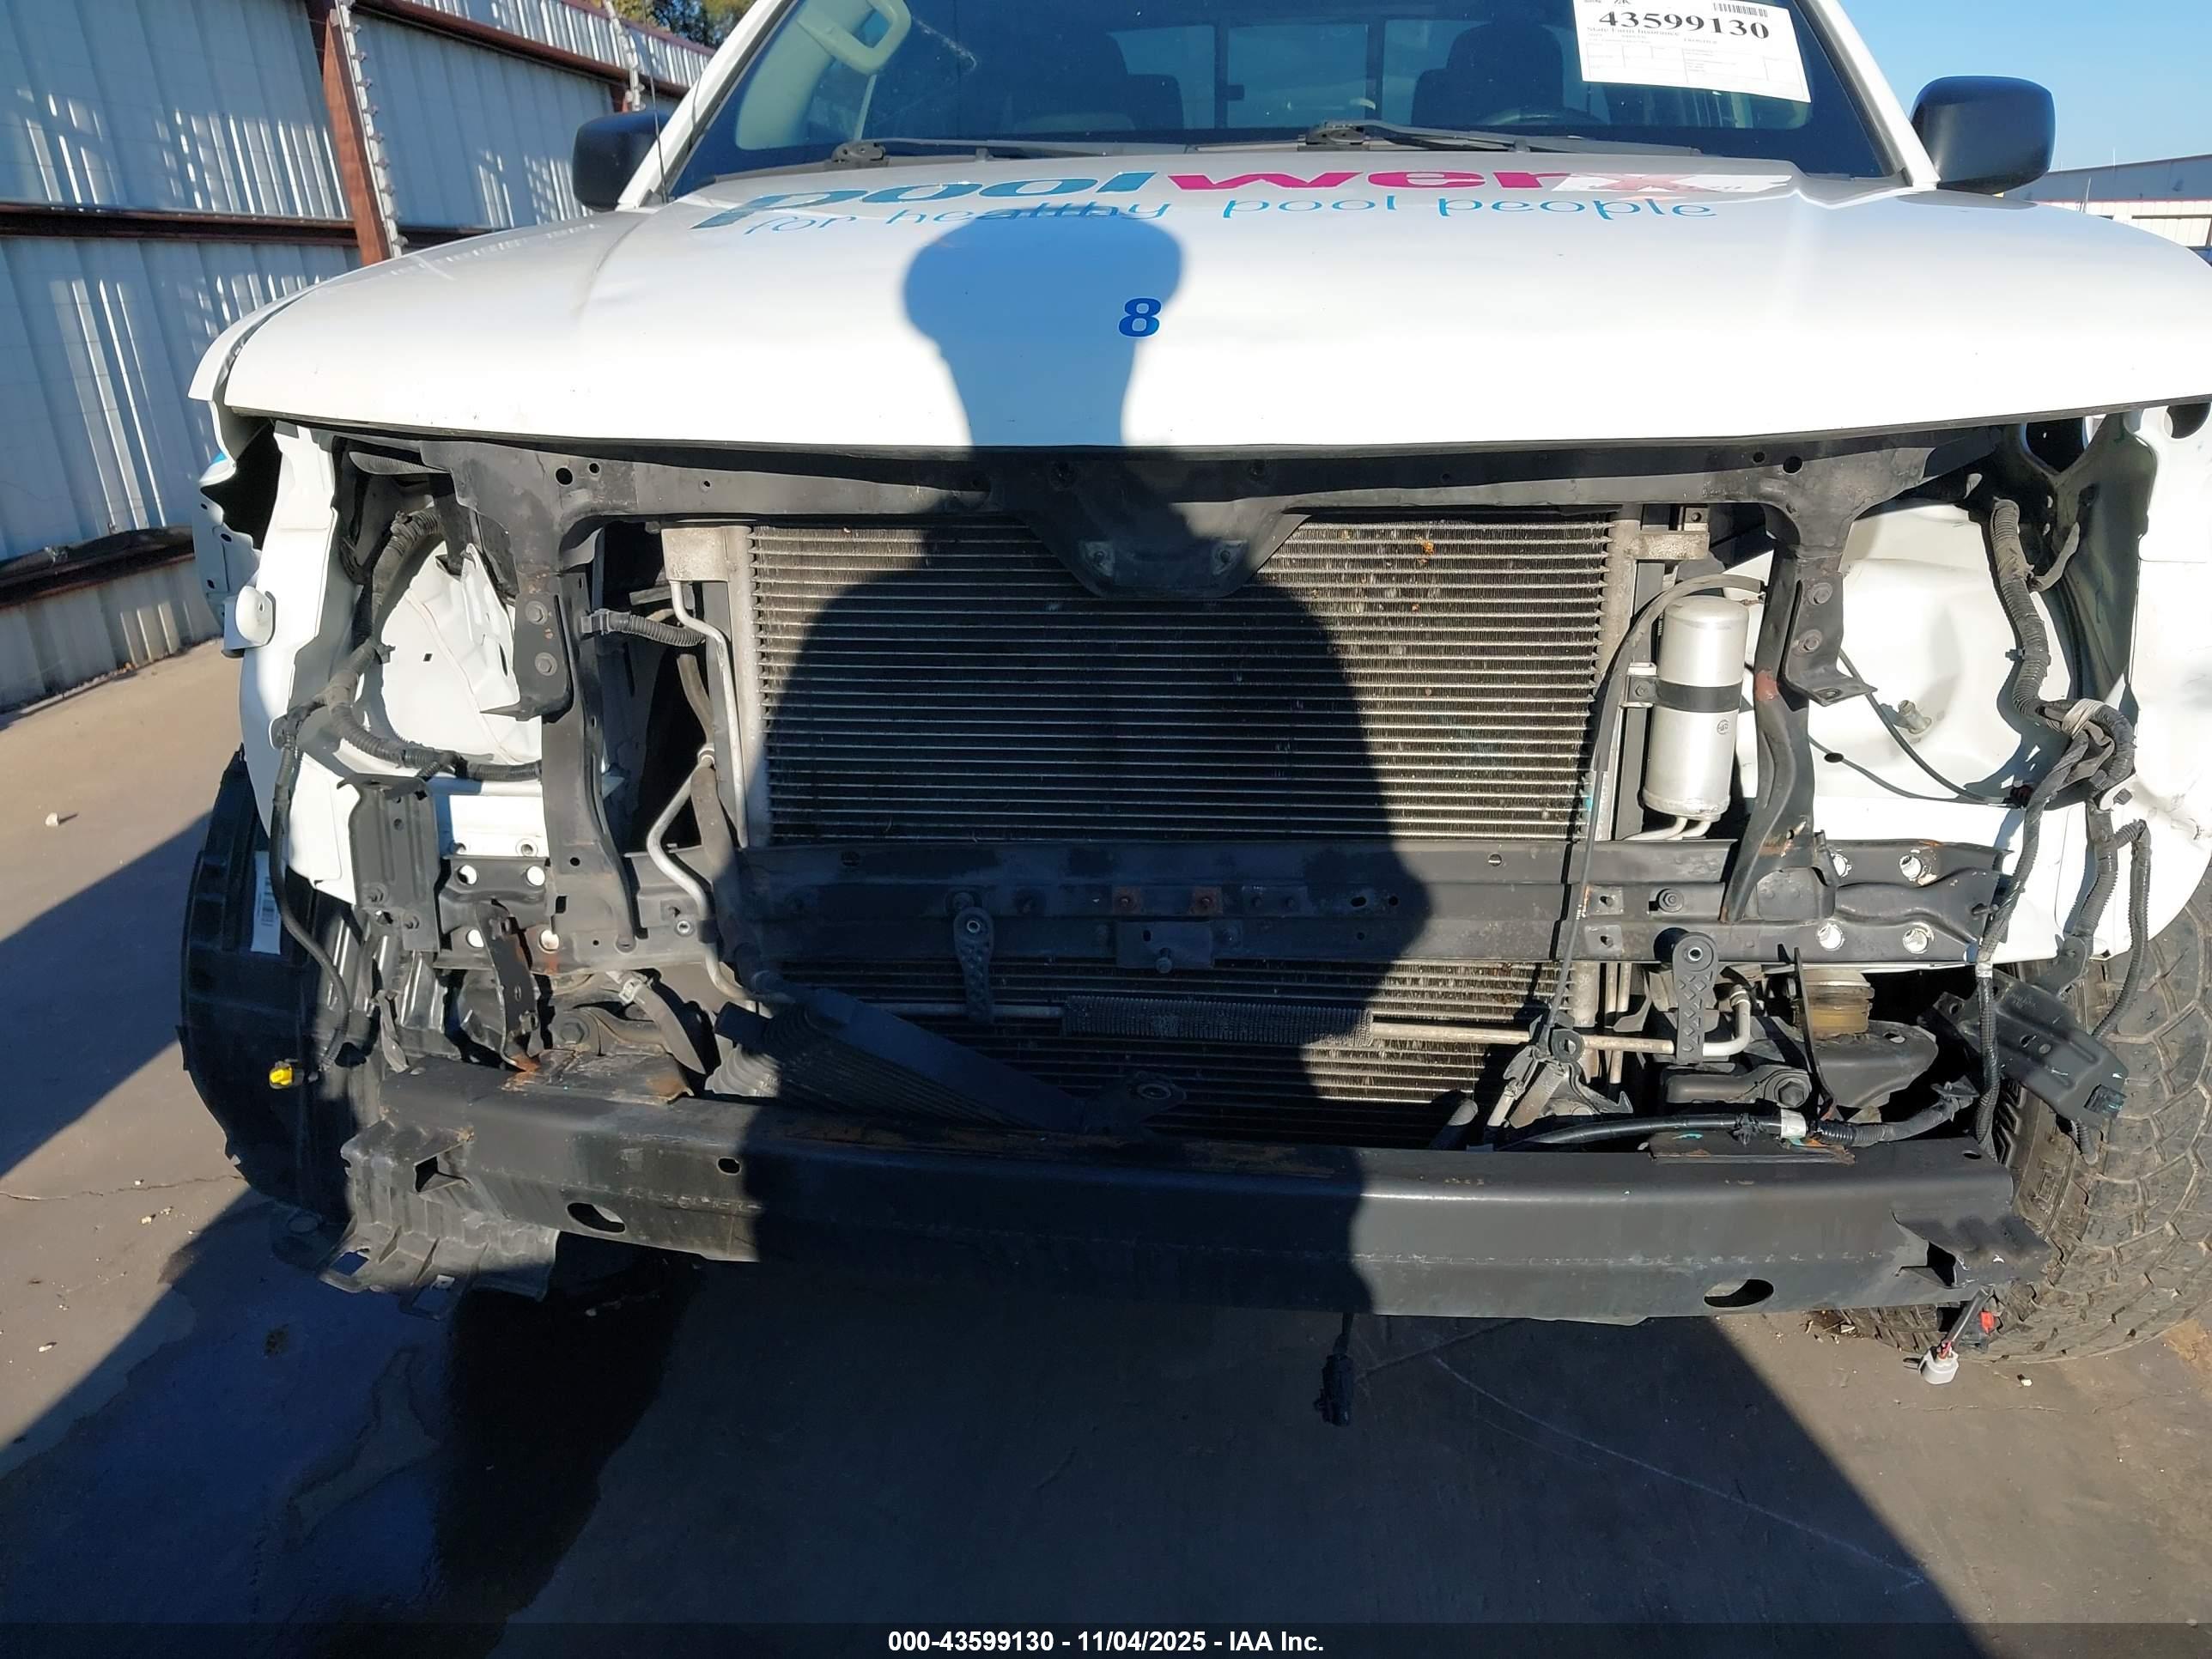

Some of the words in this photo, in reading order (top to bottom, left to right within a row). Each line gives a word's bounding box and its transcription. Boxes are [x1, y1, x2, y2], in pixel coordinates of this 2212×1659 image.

[1599, 11, 1770, 40] 43599130
[744, 215, 857, 235] for
[885, 199, 1170, 225] healthy
[1222, 195, 1397, 219] pool
[1438, 198, 1717, 221] people
[1118, 297, 1162, 337] 8
